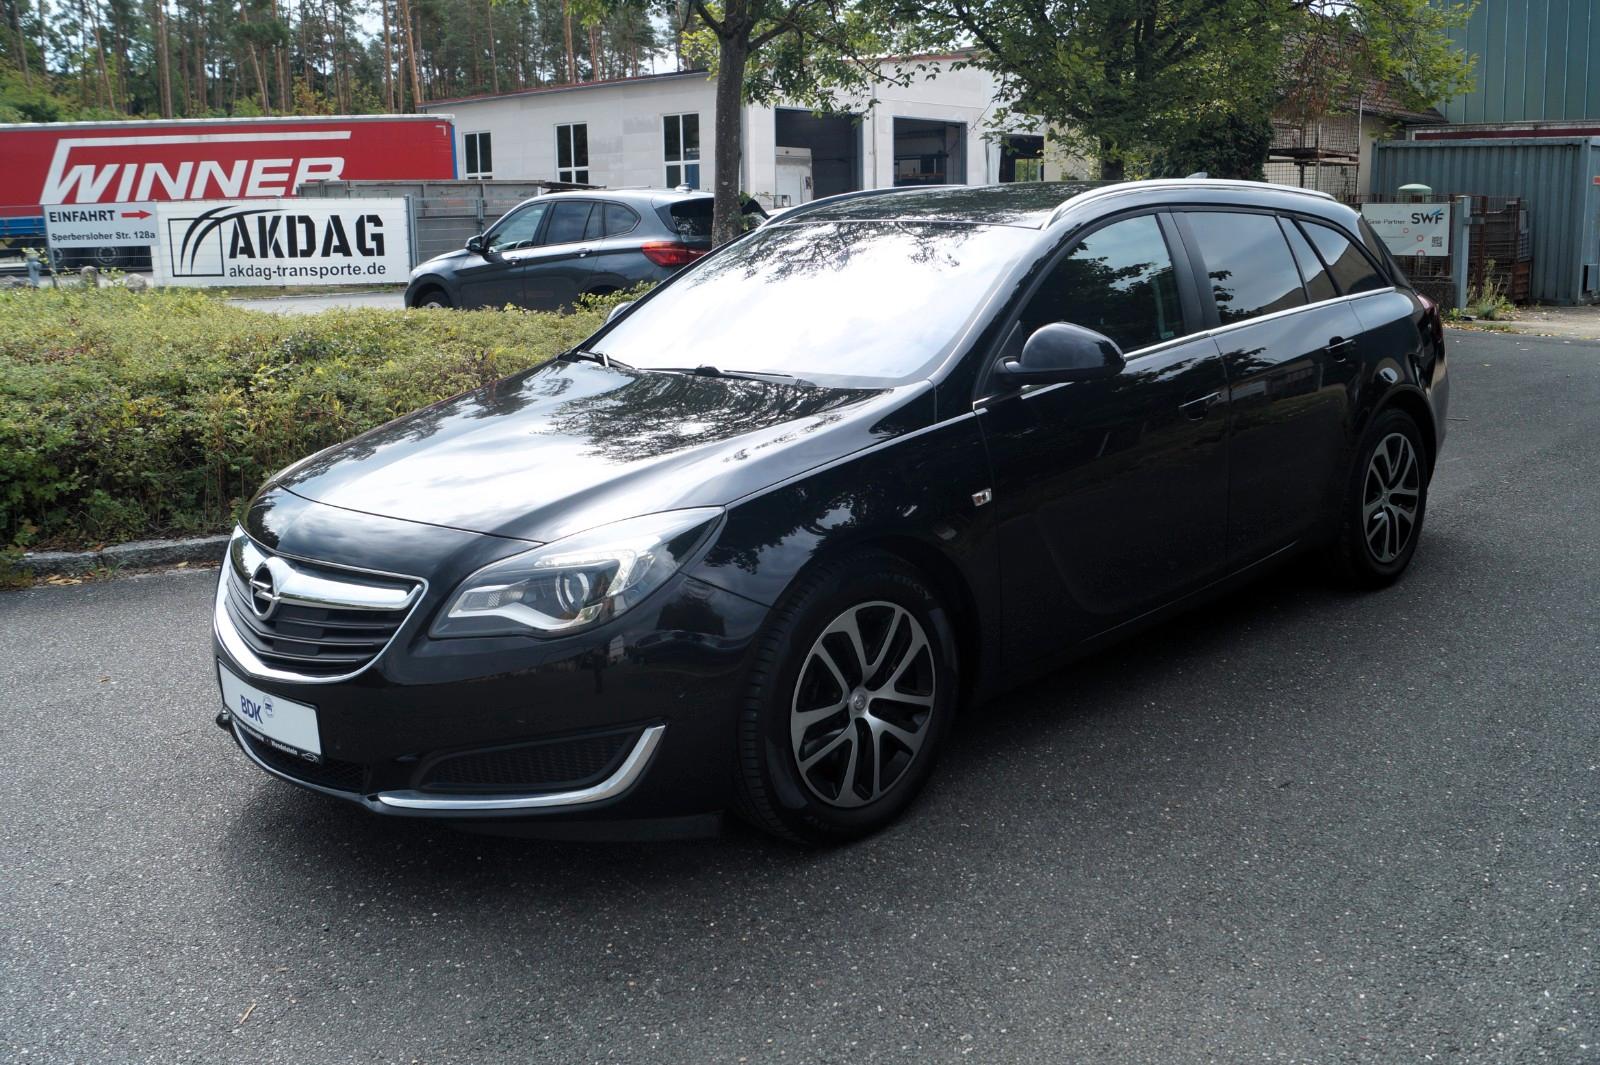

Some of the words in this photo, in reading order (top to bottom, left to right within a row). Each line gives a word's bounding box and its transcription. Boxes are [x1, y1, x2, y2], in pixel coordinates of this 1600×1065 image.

[39, 137, 346, 205] WINNER
[49, 209, 116, 223] EINFAHRT
[1411, 209, 1444, 225] SWF
[51, 232, 113, 242] Sperbersloher
[115, 231, 132, 240] Str.
[134, 230, 156, 240] 128a
[228, 214, 385, 259] AKDAG
[228, 262, 387, 281] akdag-transporte.de
[239, 694, 263, 725] BDK
